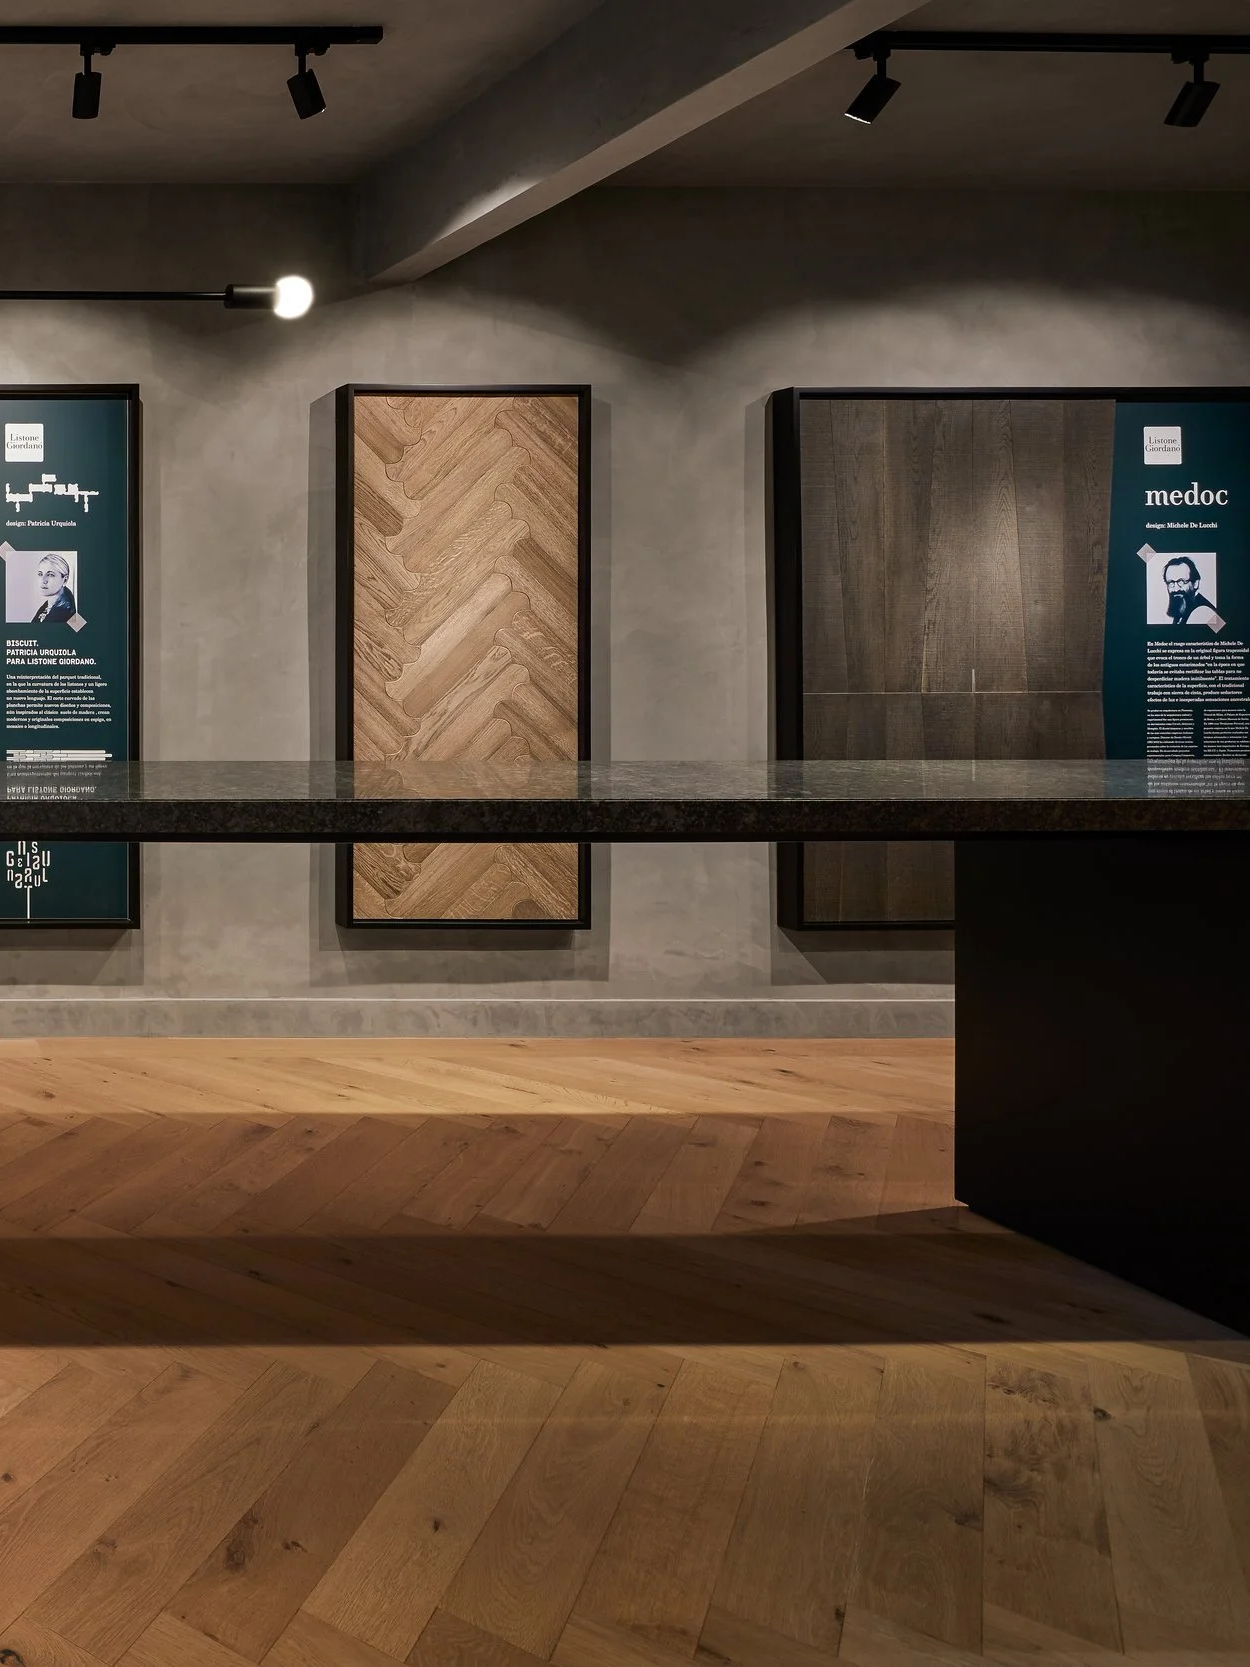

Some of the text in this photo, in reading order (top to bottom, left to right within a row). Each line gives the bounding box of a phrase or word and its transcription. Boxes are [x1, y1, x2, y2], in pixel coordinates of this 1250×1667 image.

[10, 433, 40, 442] Listone
[1148, 436, 1178, 444] Listone
[6, 441, 43, 450] Giordano
[1145, 444, 1181, 452] Giordano
[1145, 481, 1228, 506] medoc
